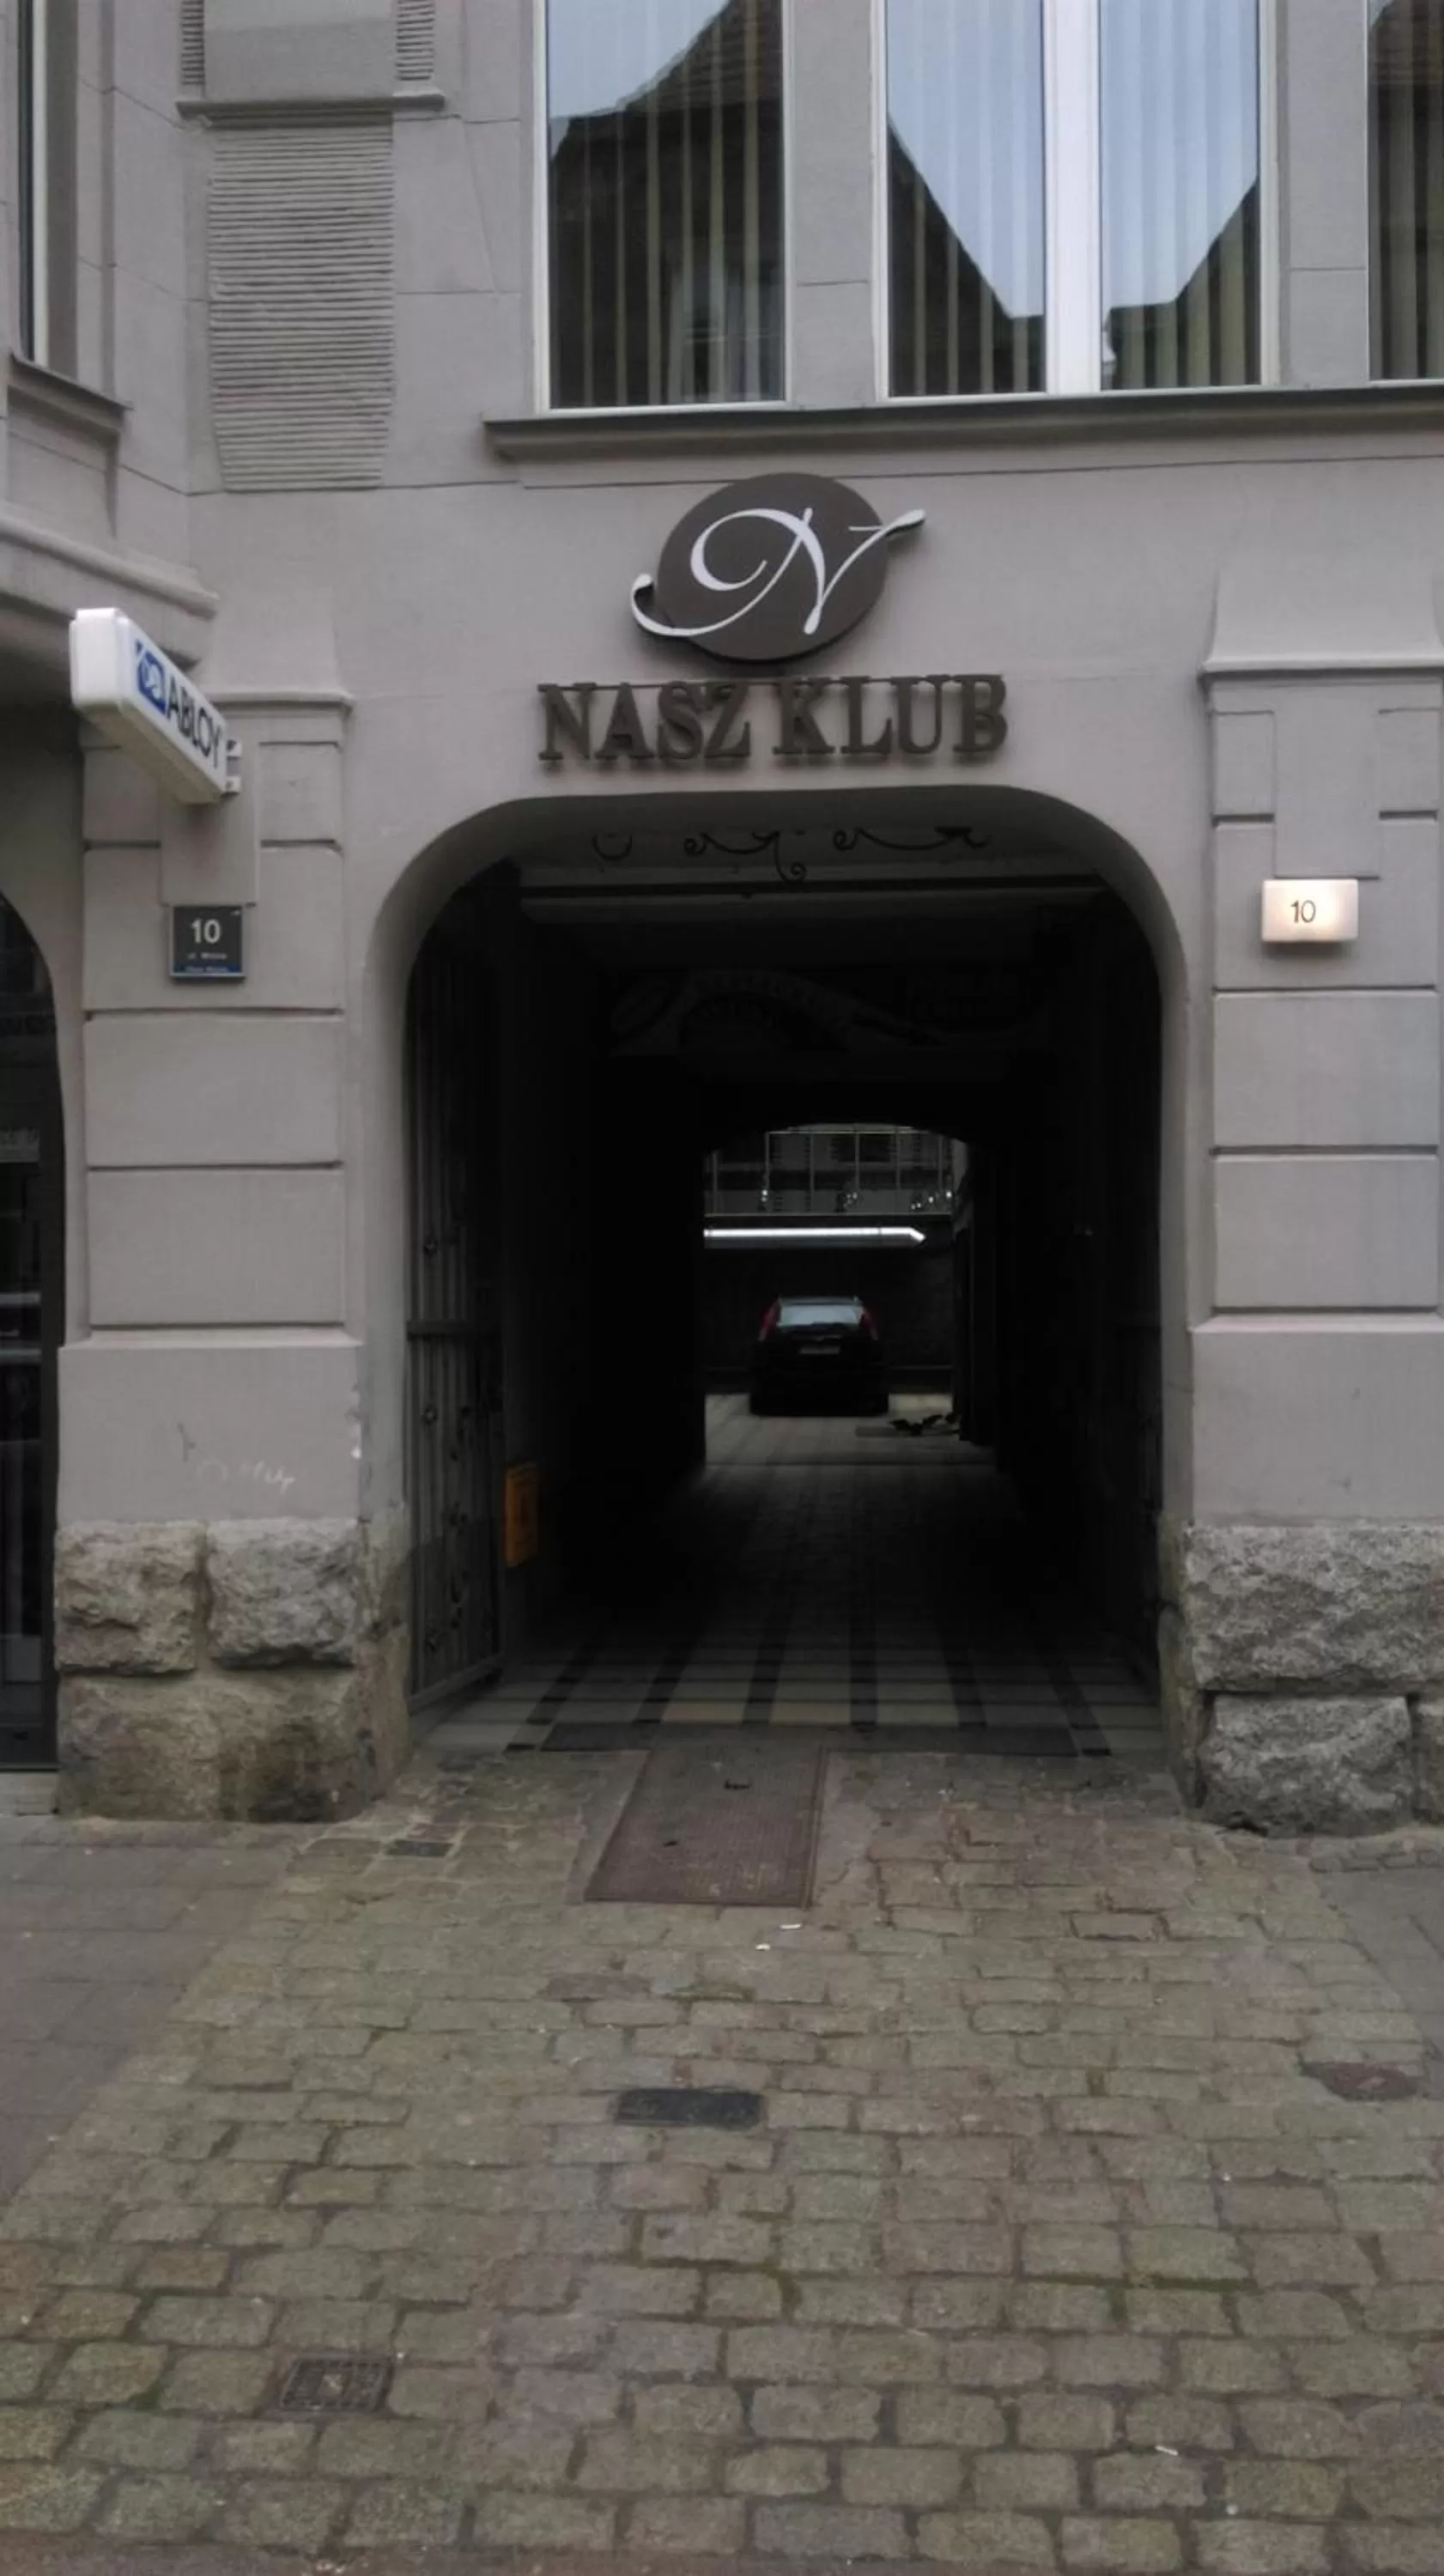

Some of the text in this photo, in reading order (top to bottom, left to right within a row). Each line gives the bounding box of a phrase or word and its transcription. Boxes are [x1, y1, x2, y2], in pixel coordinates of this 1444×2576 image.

[166, 676, 221, 770] ABLOY
[537, 674, 1009, 761] NASZ KLUB
[191, 918, 221, 944] 10
[1290, 899, 1316, 923] 10
